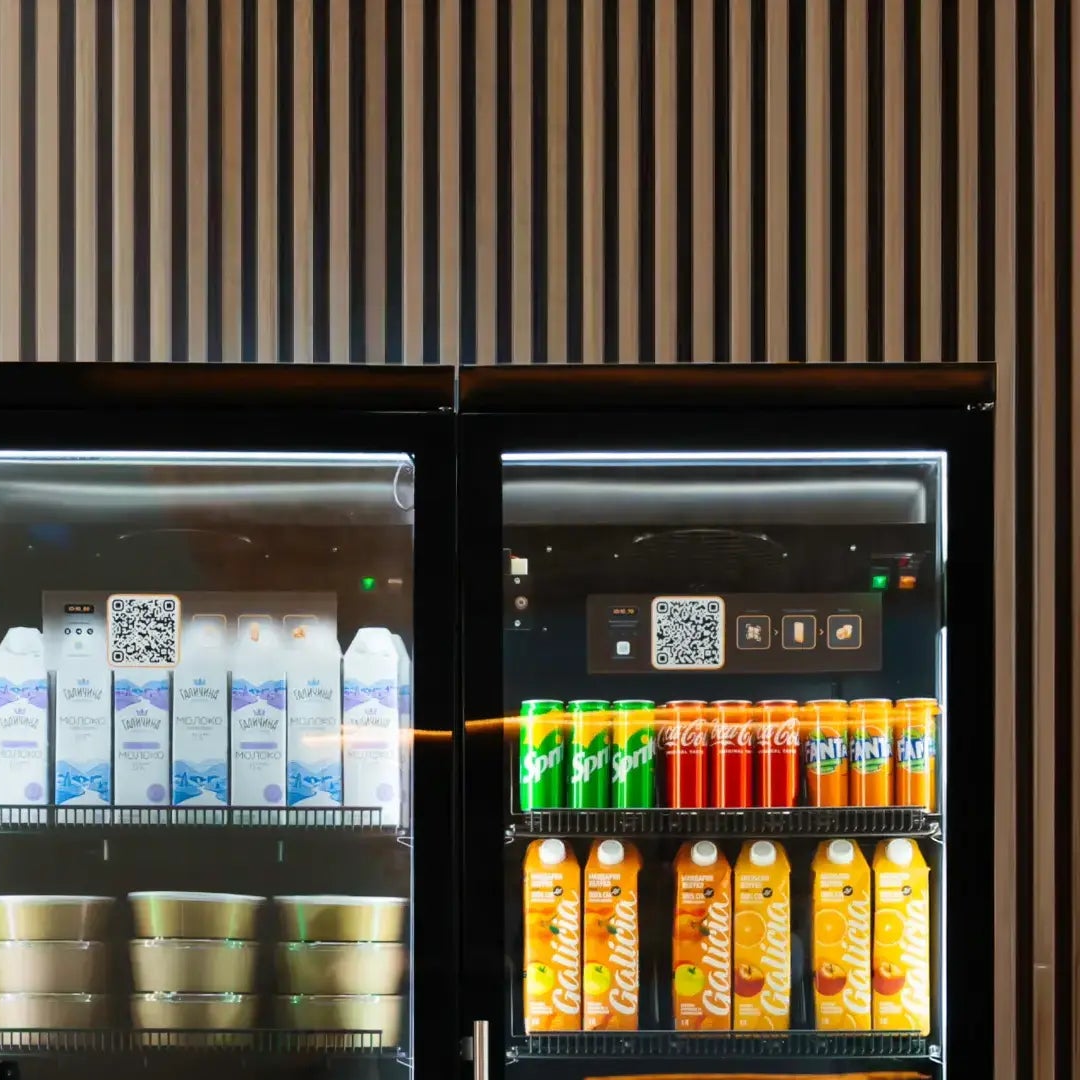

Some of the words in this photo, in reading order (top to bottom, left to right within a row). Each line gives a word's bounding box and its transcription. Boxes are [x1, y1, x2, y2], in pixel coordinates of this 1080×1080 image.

[119, 750, 164, 760] МОЛОКО
[176, 716, 223, 726] МОЛОКО
[235, 750, 281, 760] МОЛОКО
[550, 889, 580, 1015] Galicia
[607, 890, 638, 1015] Galicia
[701, 892, 731, 1016] Galicia
[760, 892, 790, 1016] Galicia
[842, 889, 871, 1014] Galicia
[900, 889, 928, 1014] Galicia
